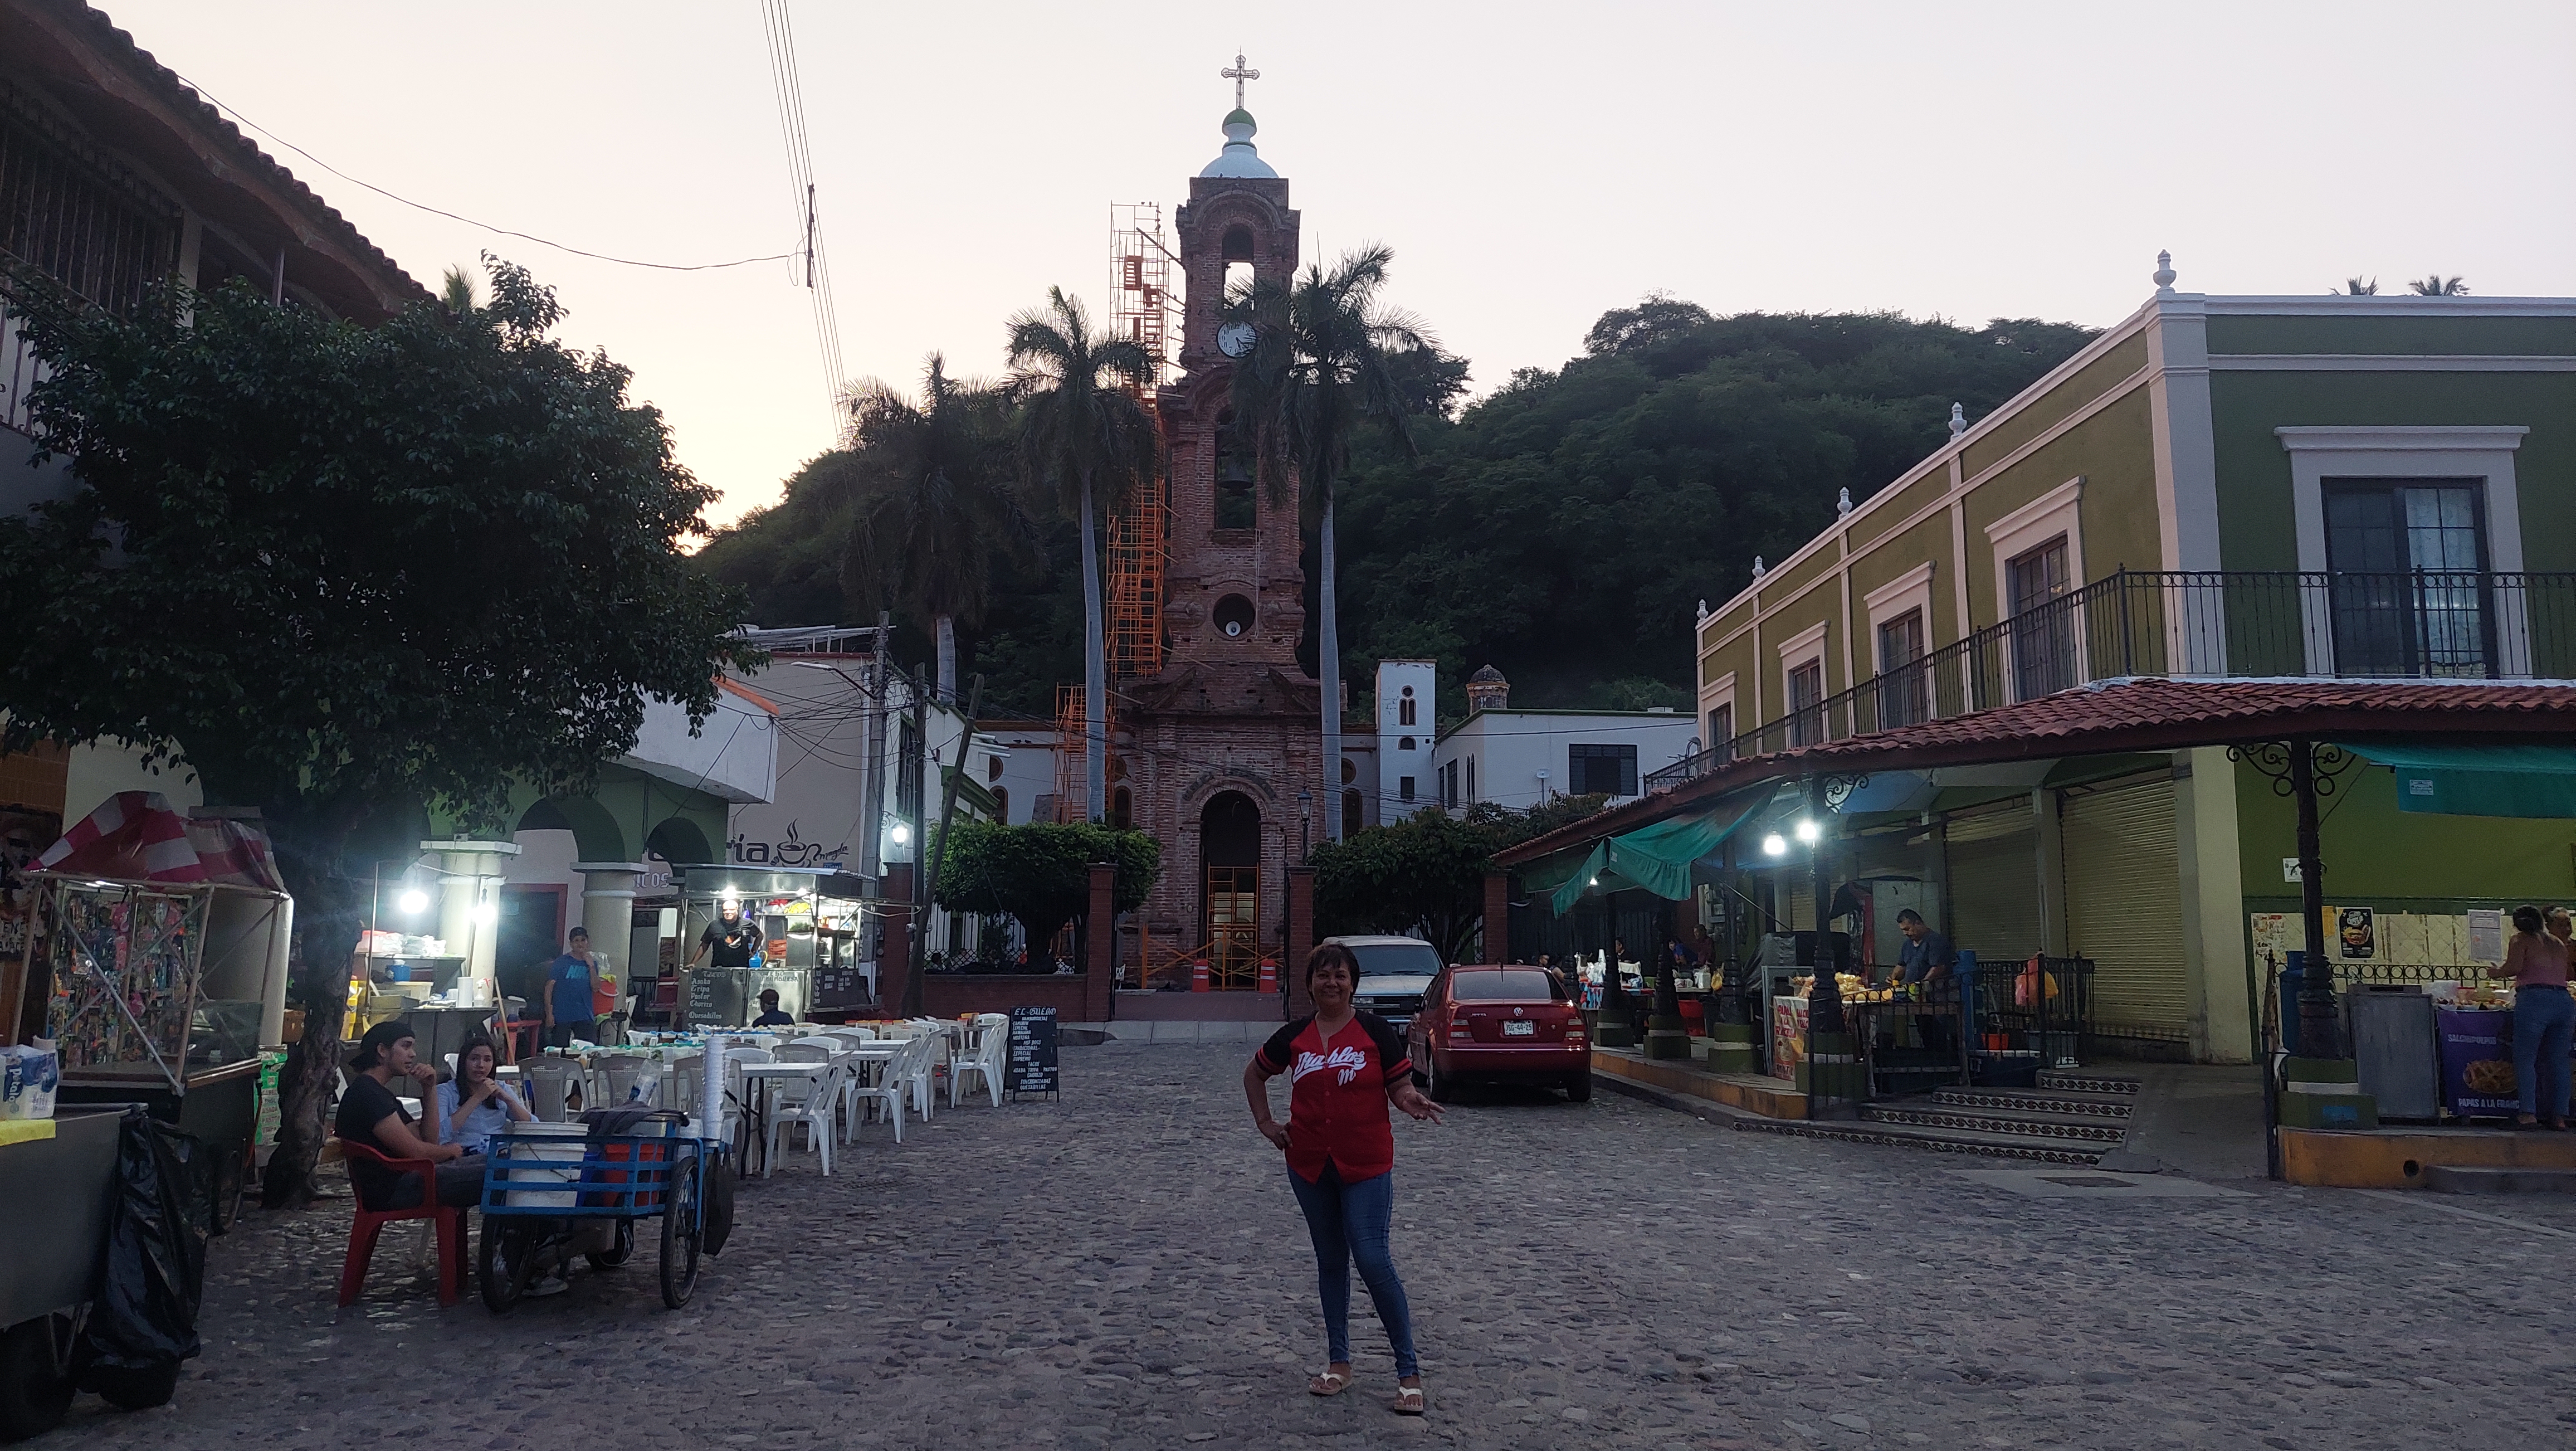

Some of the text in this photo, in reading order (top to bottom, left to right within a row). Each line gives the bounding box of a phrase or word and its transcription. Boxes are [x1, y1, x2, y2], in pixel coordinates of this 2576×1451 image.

[819, 843, 848, 860] magda
[2458, 1098, 2480, 1108] PAPAS
[2481, 1099, 2486, 1108] A
[2486, 1099, 2496, 1108] LA
